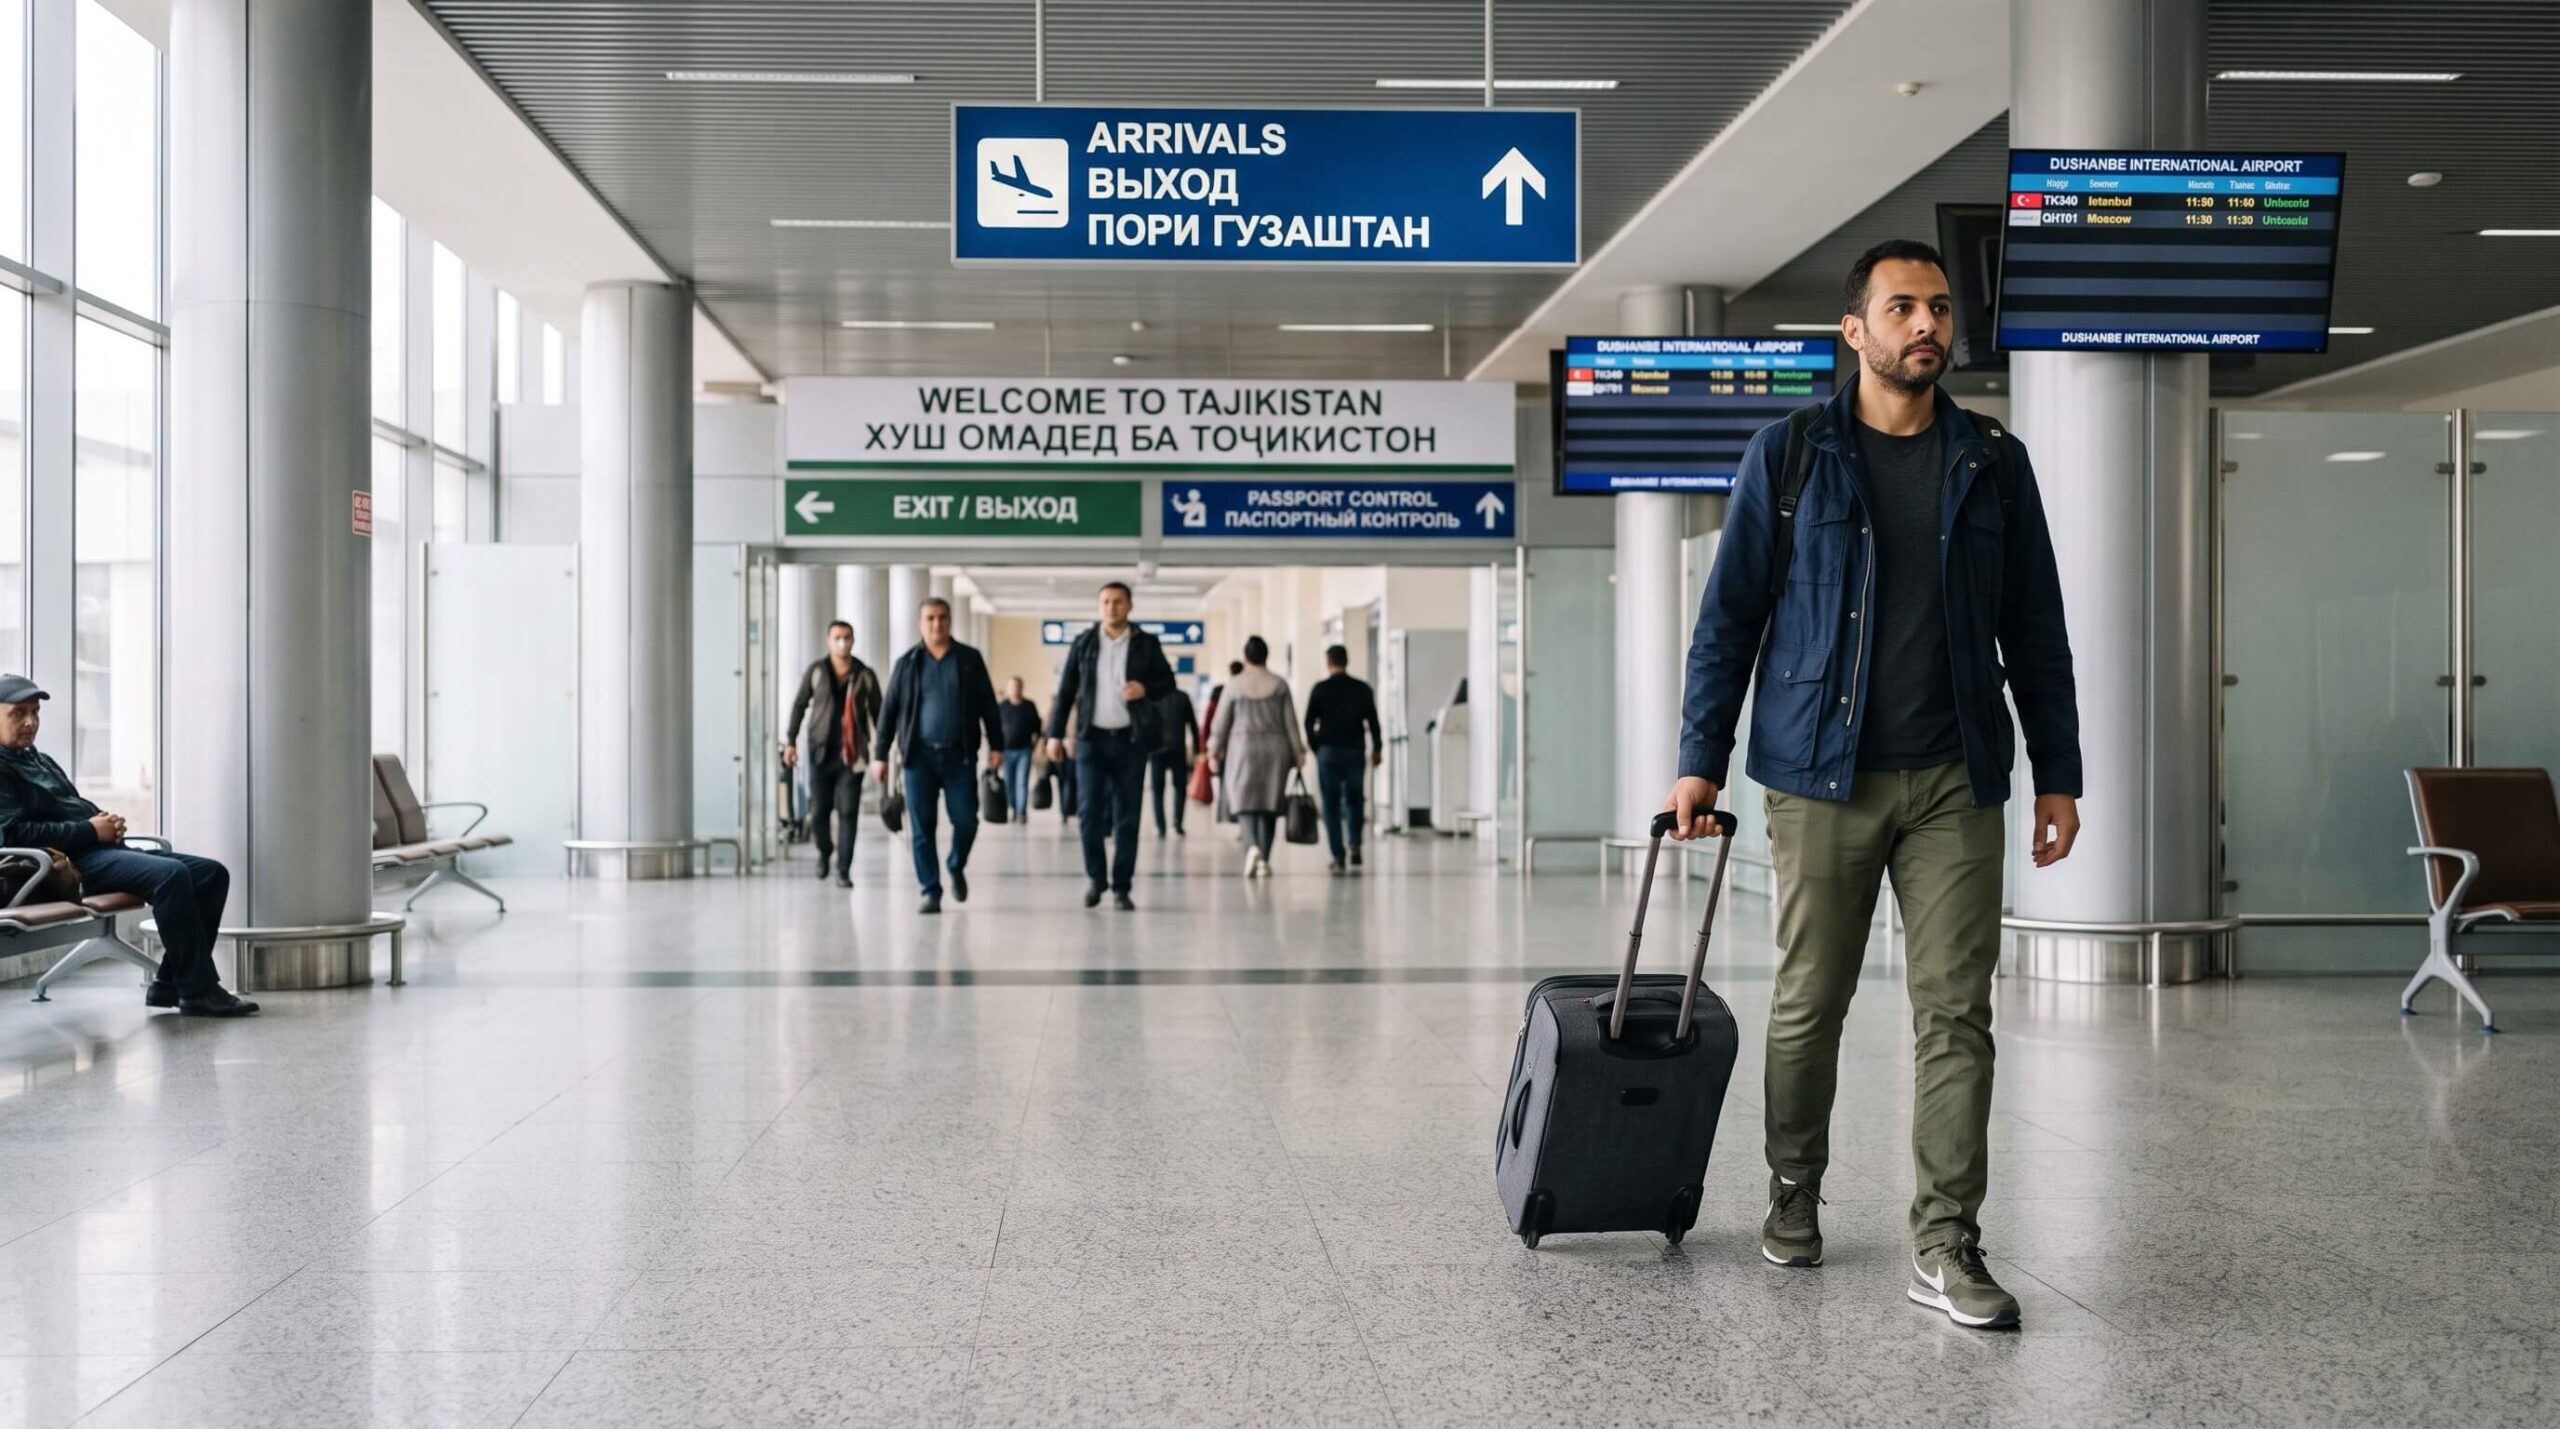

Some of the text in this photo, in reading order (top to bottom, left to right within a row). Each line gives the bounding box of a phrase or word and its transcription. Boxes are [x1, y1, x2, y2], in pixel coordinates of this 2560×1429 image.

[1087, 122, 1287, 155] ARRIVALS
[2050, 158, 2304, 173] DUSHANBE INTERNATIONAL AIRPORT
[1088, 168, 1239, 206] ВЫХОД
[2043, 195, 2079, 206] TK340
[1088, 214, 1430, 247] ПОРИ ГУЗАШТАН
[2087, 213, 2132, 224] Moscow
[2062, 332, 2261, 345] DUSHANBE INTERNATIONAL AIRPORT
[919, 388, 1382, 416] WELCOME TO TAJIKISTAN
[865, 424, 1436, 458] ХУШ ОМАДЕД БА ТОҶИКИСТОН
[894, 495, 1079, 524] EXIT / ВЫХОД
[1248, 490, 1438, 507] PASSPORT CONTROL
[1225, 508, 1461, 529] ПАСПОРТНЫЙ КОНТРОЛЬ
